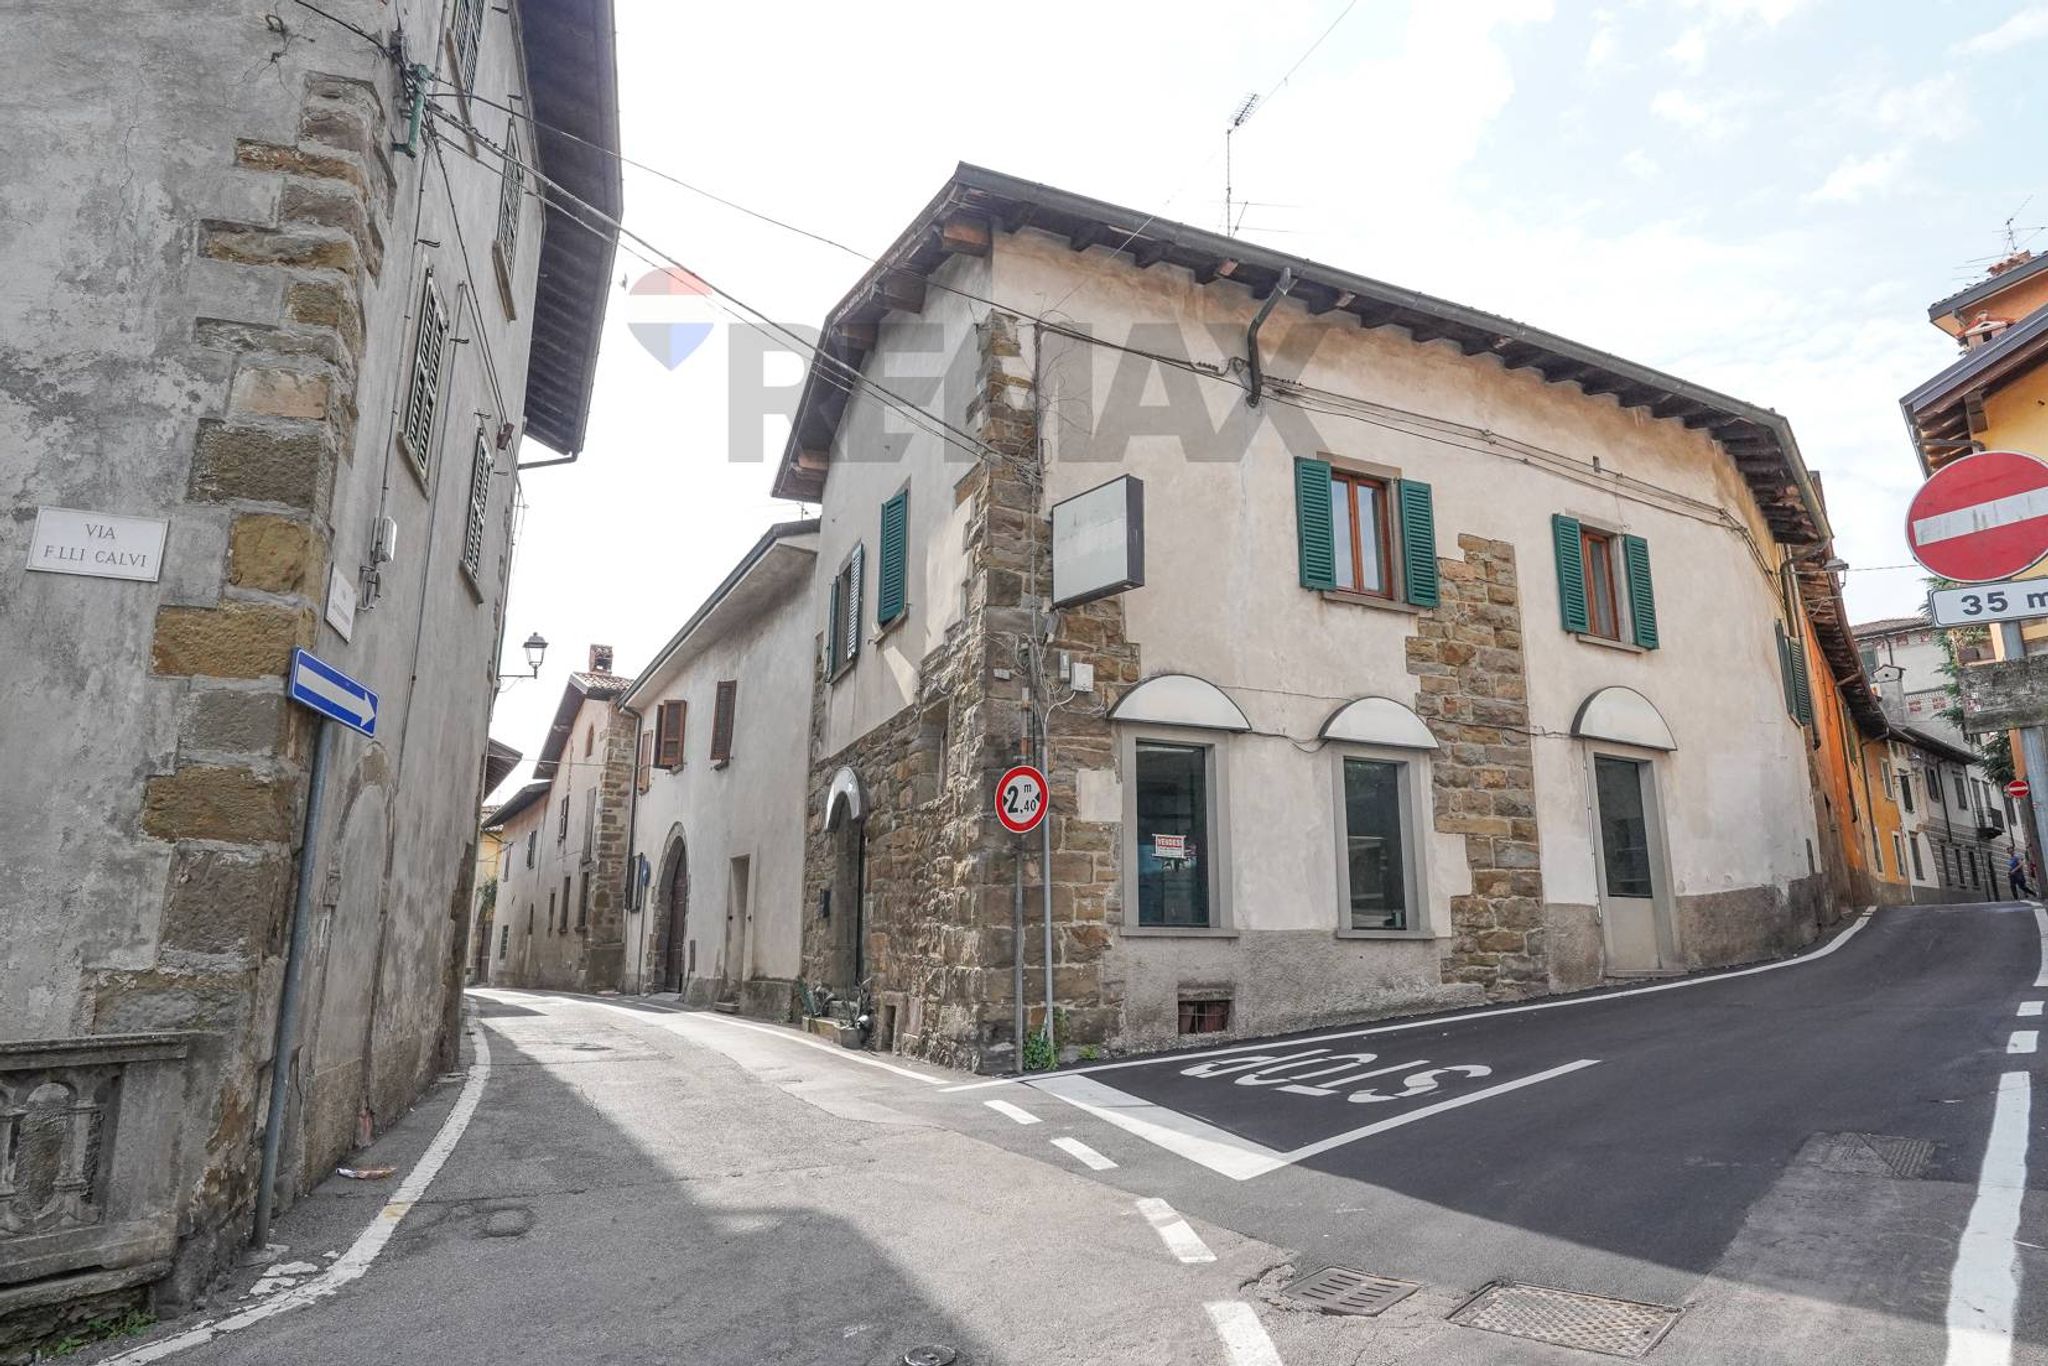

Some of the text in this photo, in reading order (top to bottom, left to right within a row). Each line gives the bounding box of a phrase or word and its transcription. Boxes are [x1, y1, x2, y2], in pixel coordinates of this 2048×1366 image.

[85, 523, 116, 540] VIA
[95, 550, 147, 568] CALVI
[1961, 590, 2009, 616] 35
[1023, 783, 1033, 794] m
[1180, 1048, 1493, 1103] STOP
